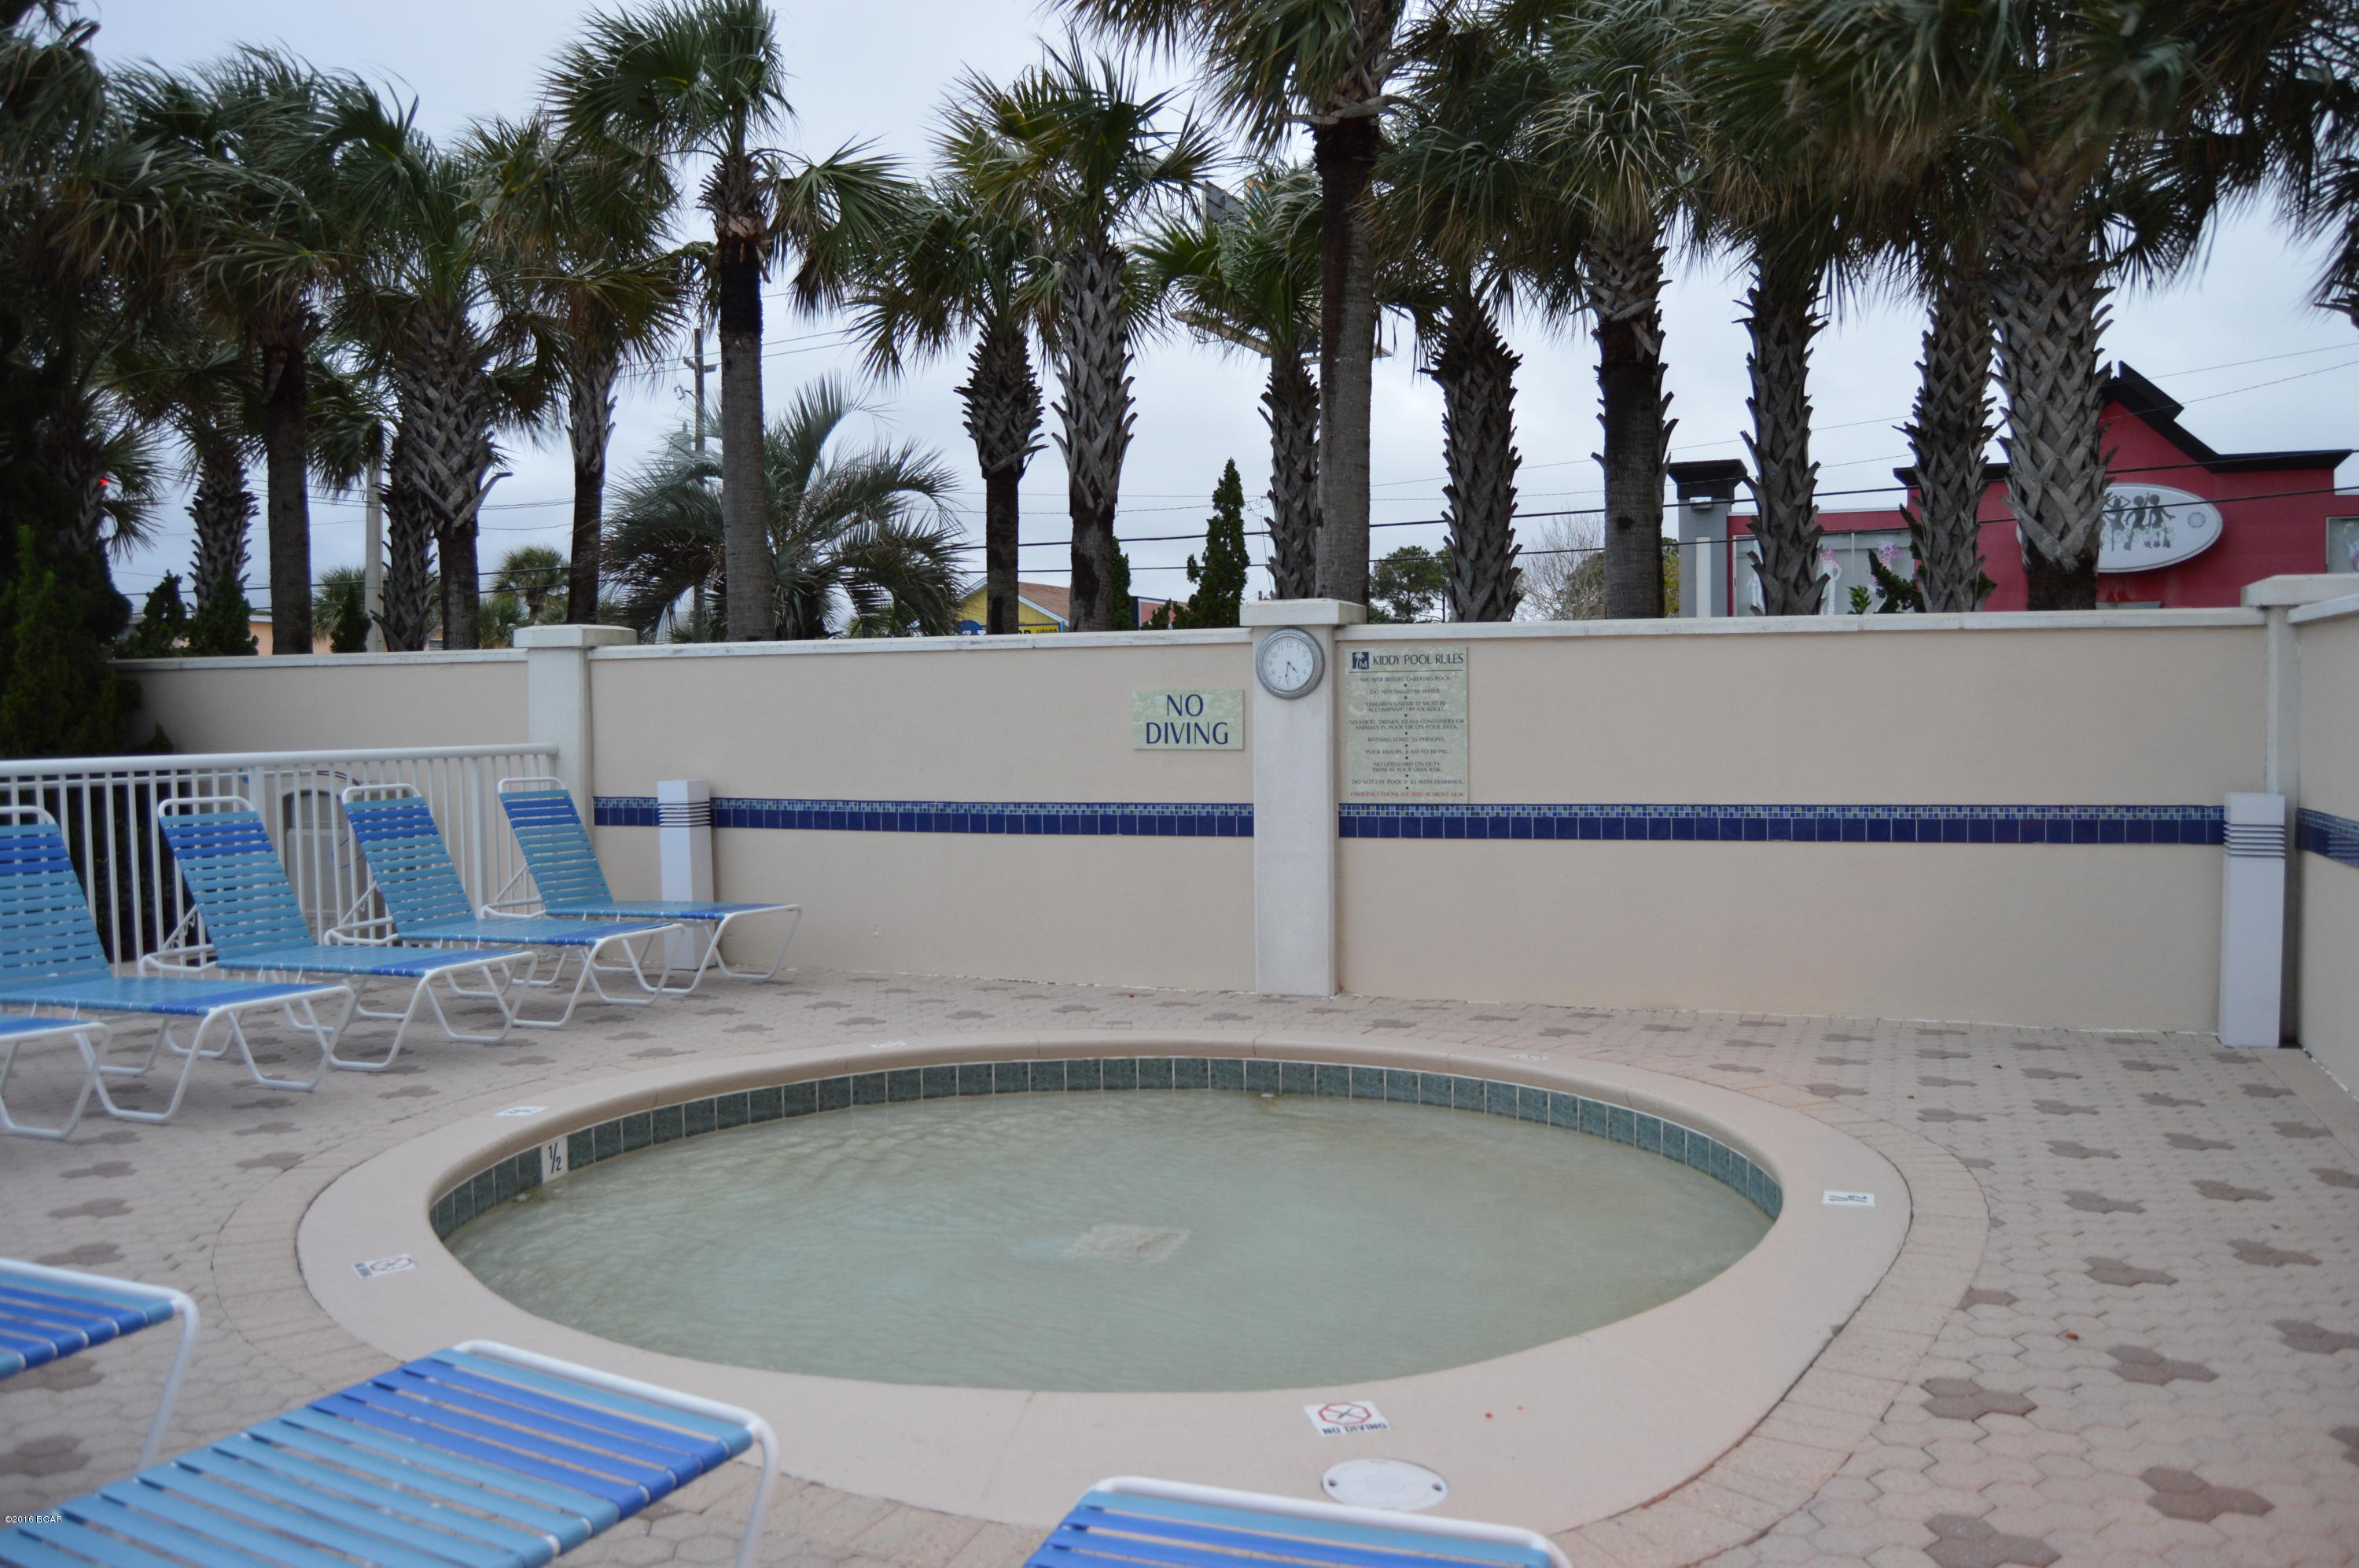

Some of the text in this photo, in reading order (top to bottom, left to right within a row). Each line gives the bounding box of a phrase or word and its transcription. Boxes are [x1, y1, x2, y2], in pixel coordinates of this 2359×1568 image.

[1373, 653, 1464, 665] KIDDY POOL RULES
[1167, 694, 1204, 716] NO
[1146, 722, 1228, 744] DIVING
[1345, 1423, 1387, 1432] DIVING
